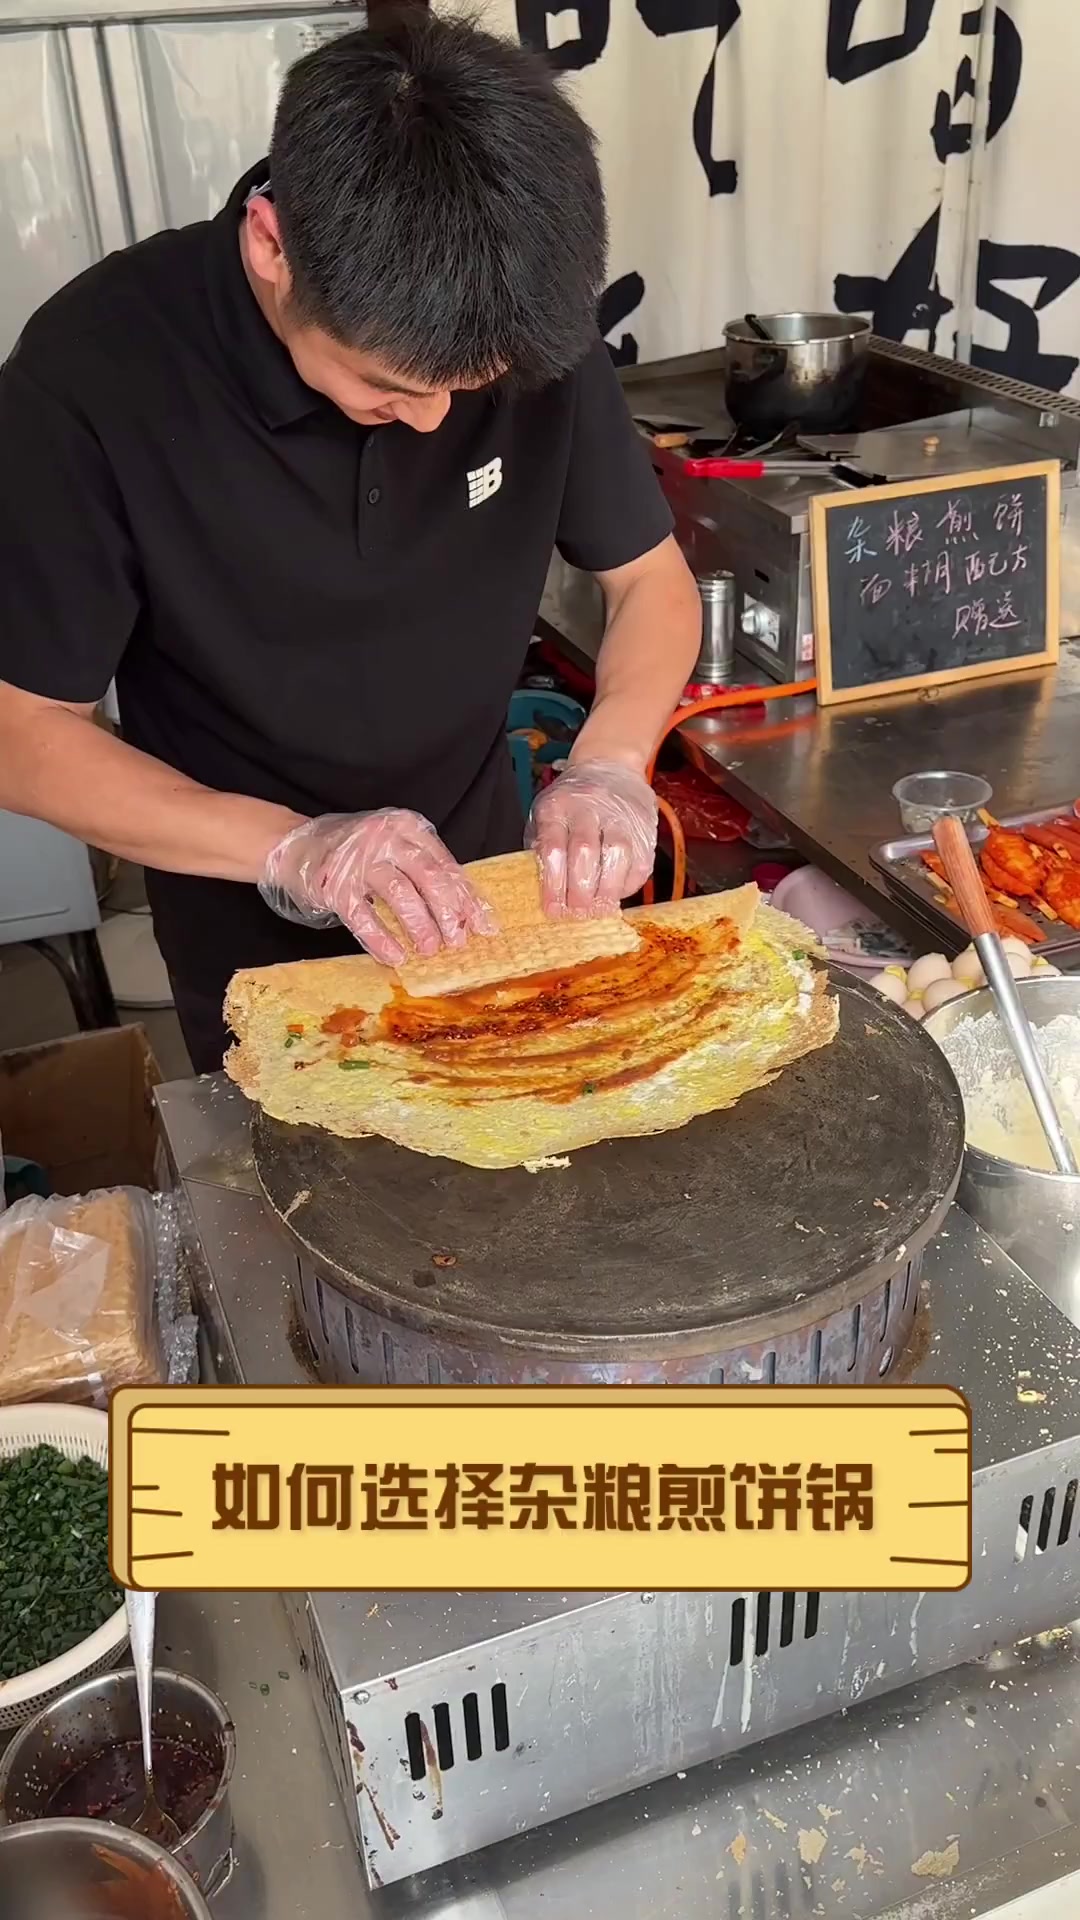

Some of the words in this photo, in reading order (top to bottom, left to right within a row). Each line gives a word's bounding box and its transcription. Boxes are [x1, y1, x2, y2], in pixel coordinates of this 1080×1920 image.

[844, 493, 1027, 564] 杂粮煎饼
[952, 591, 1022, 640] 赠送
